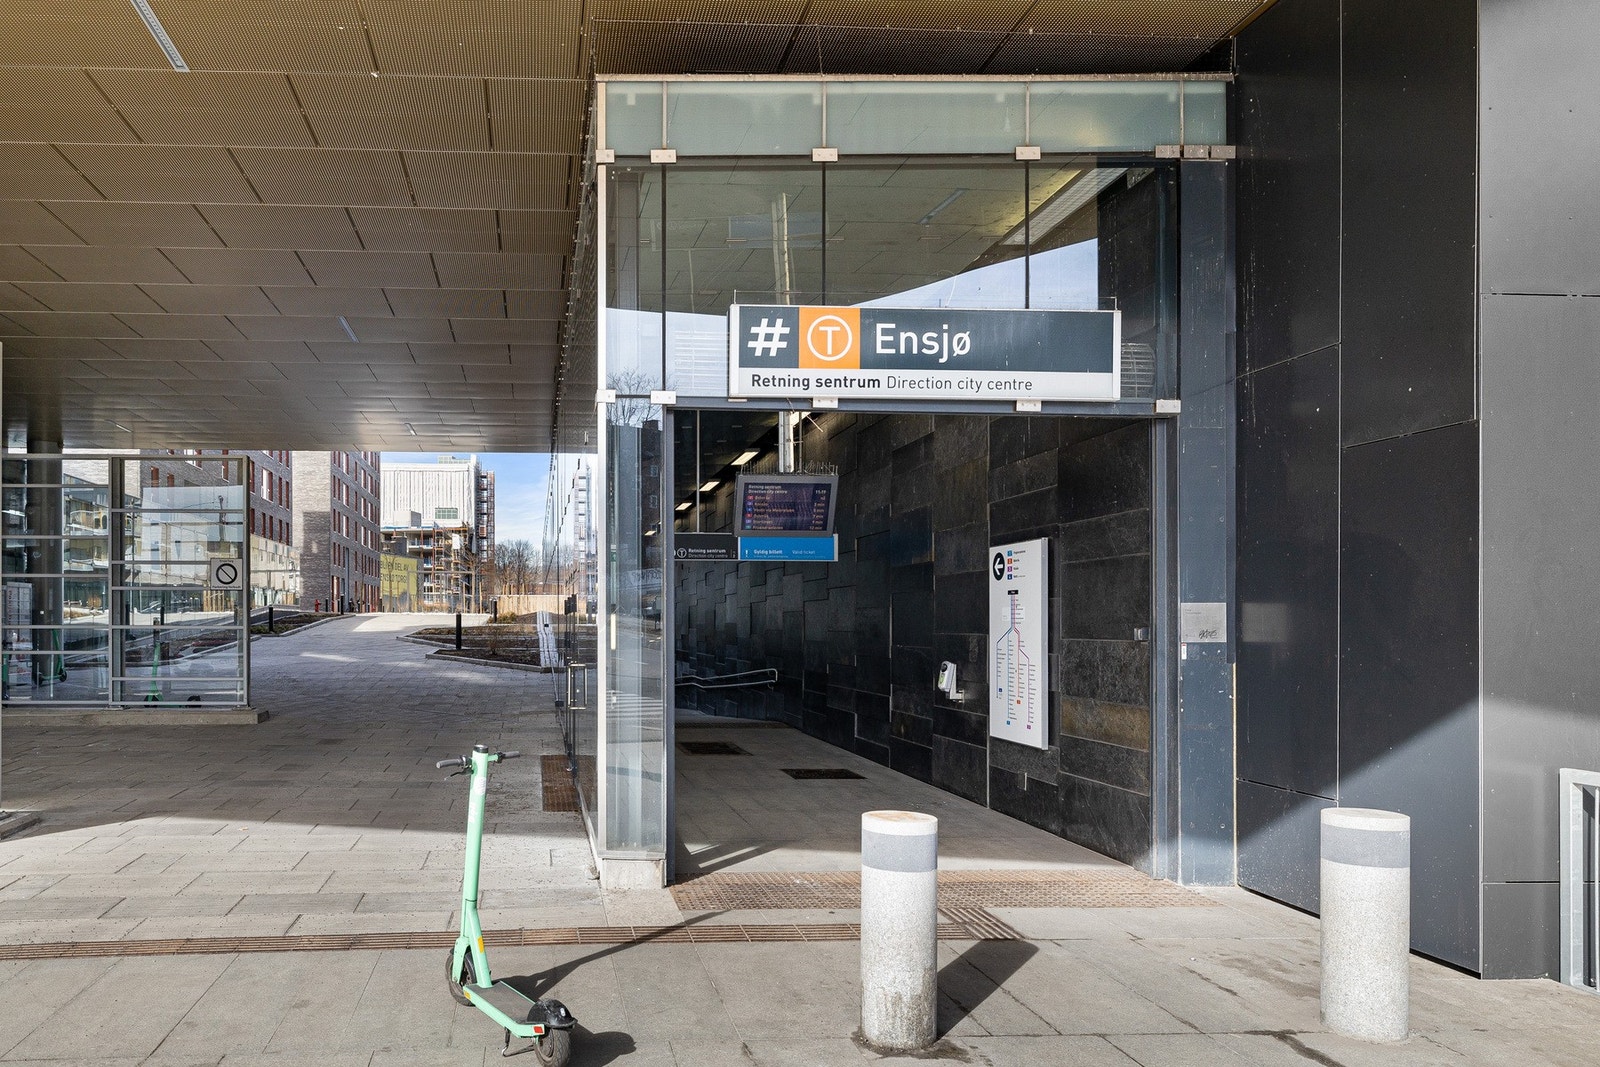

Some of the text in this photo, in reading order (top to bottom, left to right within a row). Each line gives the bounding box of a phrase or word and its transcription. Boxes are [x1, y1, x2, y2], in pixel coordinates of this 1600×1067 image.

[876, 323, 971, 363] Ensjø
[751, 373, 1033, 393] Retning sentrum Direction city centre
